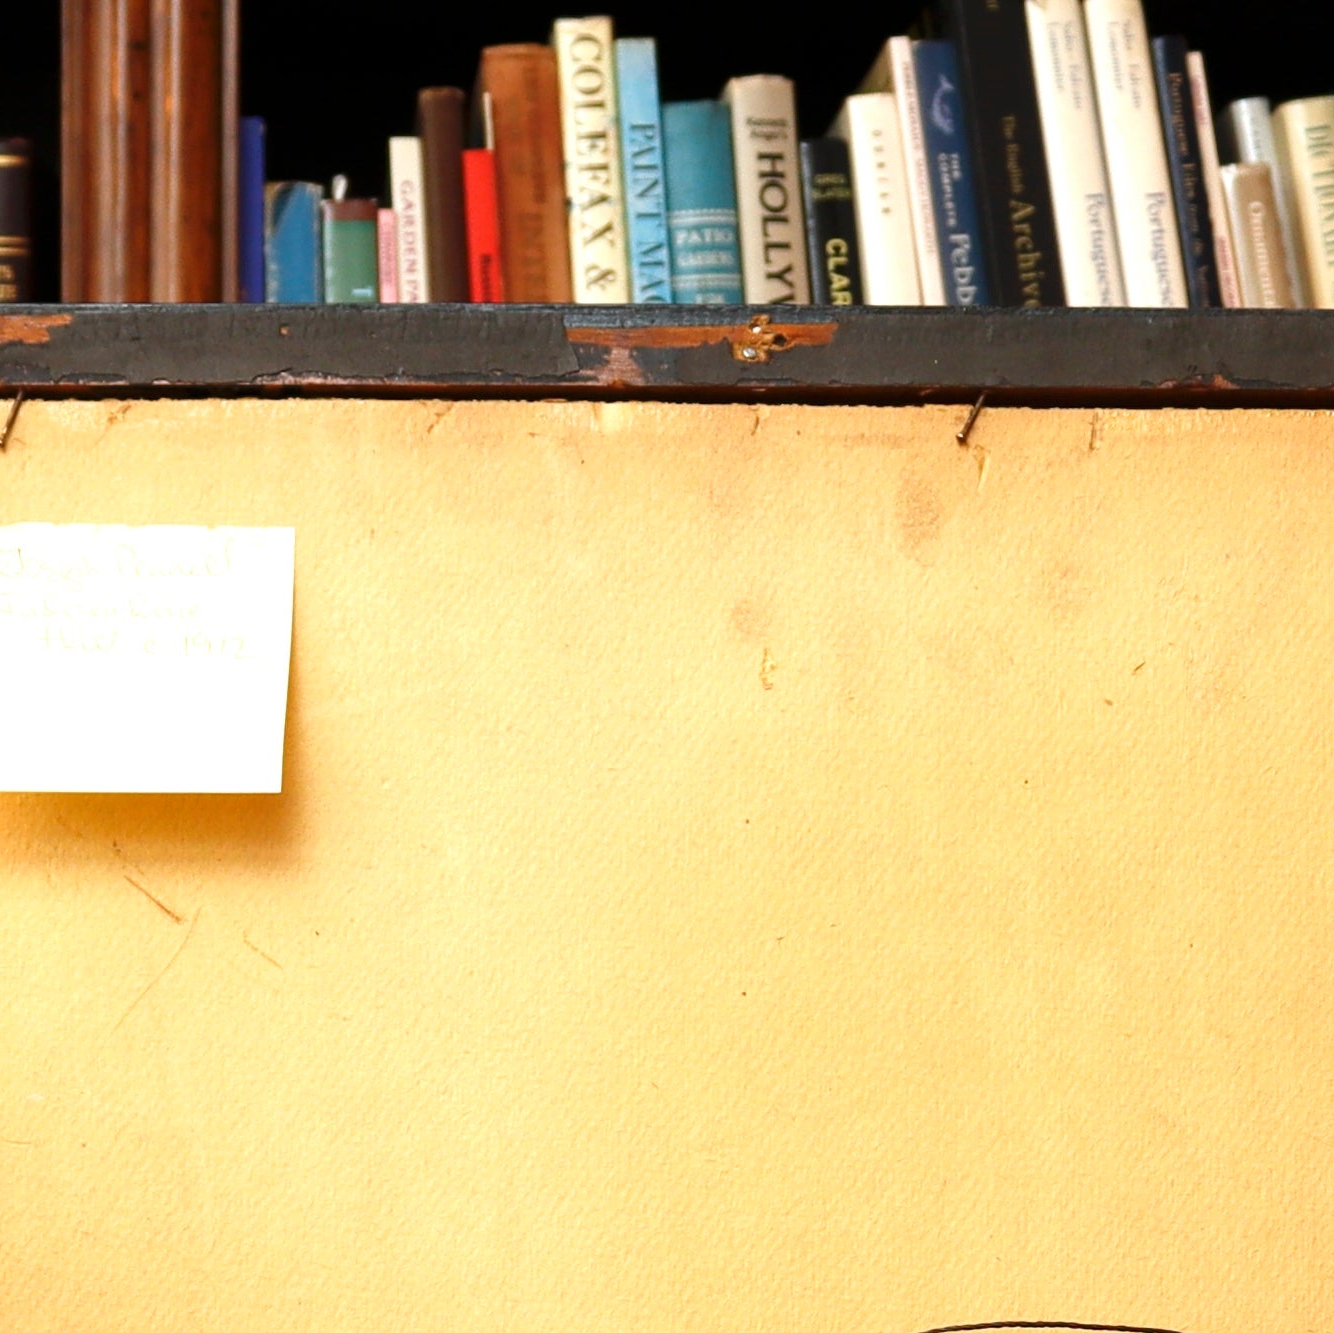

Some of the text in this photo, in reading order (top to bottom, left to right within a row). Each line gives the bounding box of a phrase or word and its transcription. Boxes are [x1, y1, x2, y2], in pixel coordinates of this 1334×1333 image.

[569, 33, 618, 293] COLEFAX &
[630, 122, 663, 228] PAINT
